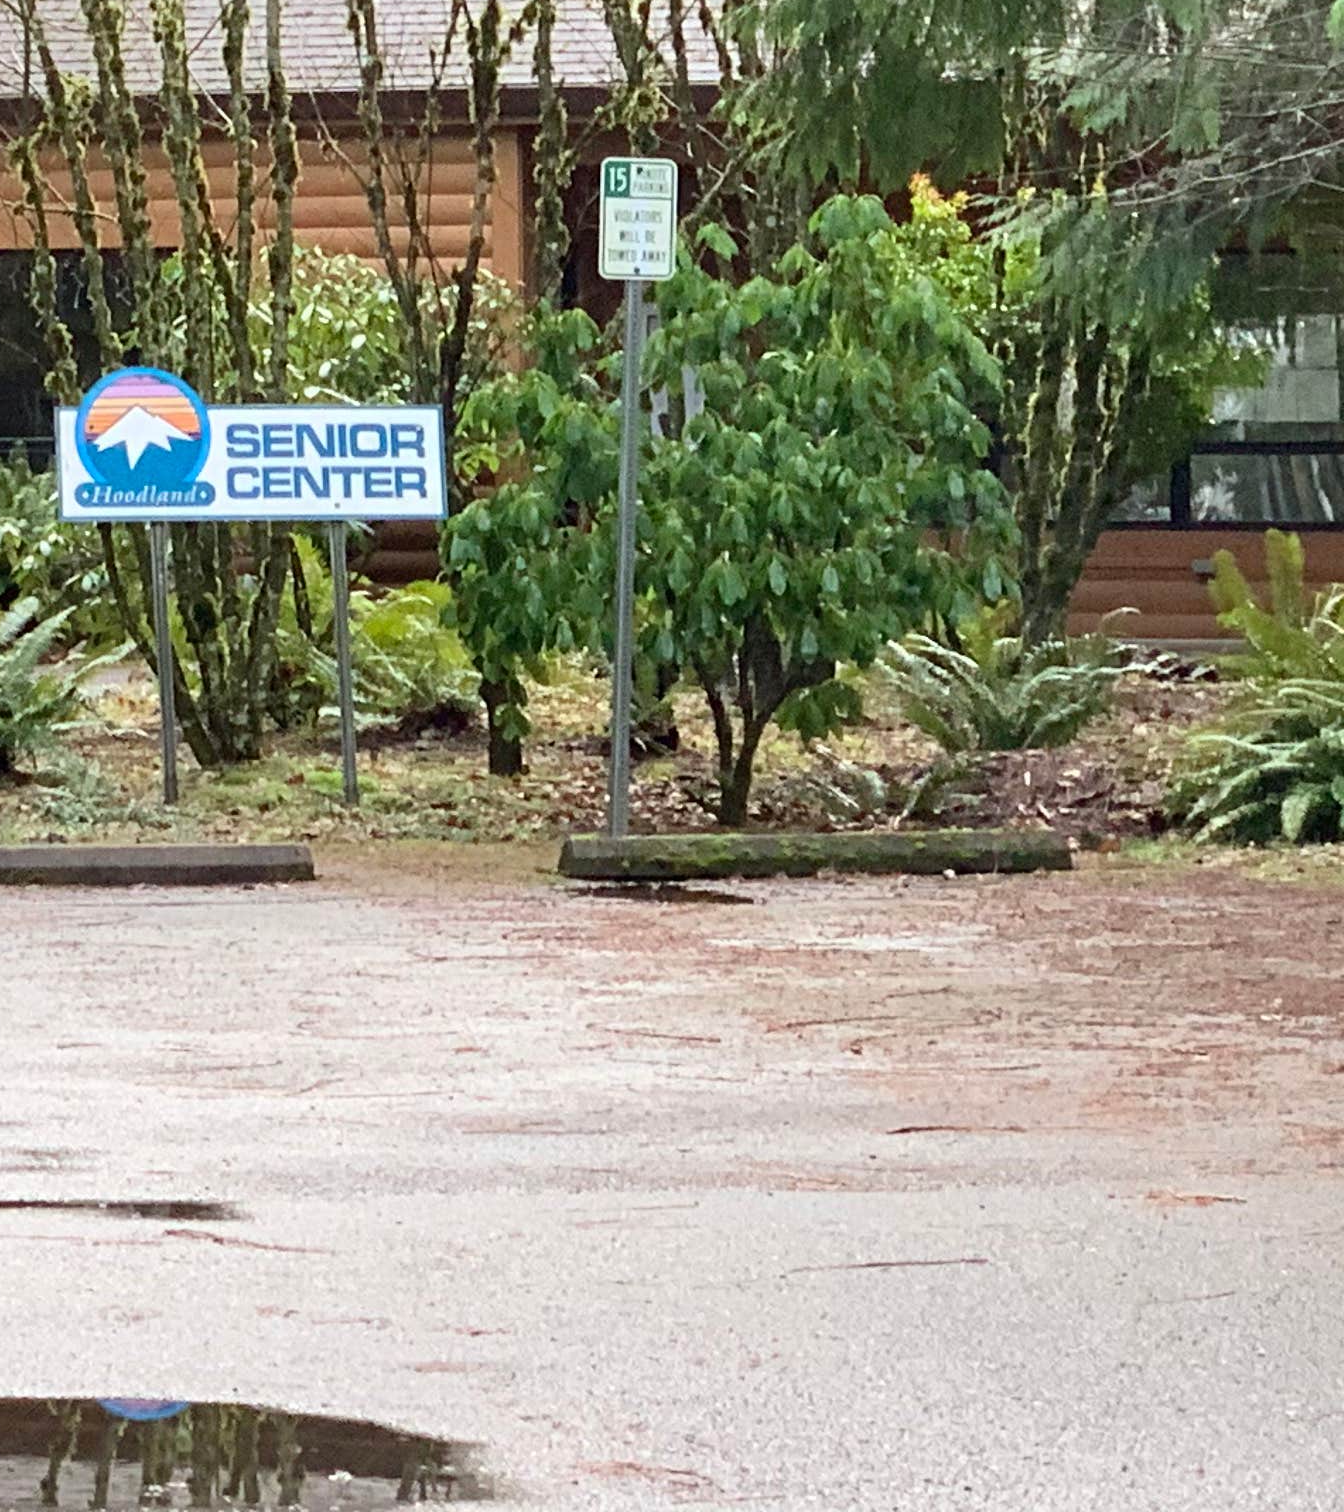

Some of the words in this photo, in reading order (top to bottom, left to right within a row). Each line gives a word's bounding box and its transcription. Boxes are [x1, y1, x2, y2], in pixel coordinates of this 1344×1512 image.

[609, 166, 628, 192] 15
[640, 249, 666, 263] AWAY
[226, 423, 426, 459] SENIOR
[92, 484, 197, 506] Hoodland
[226, 466, 428, 500] CENTER
